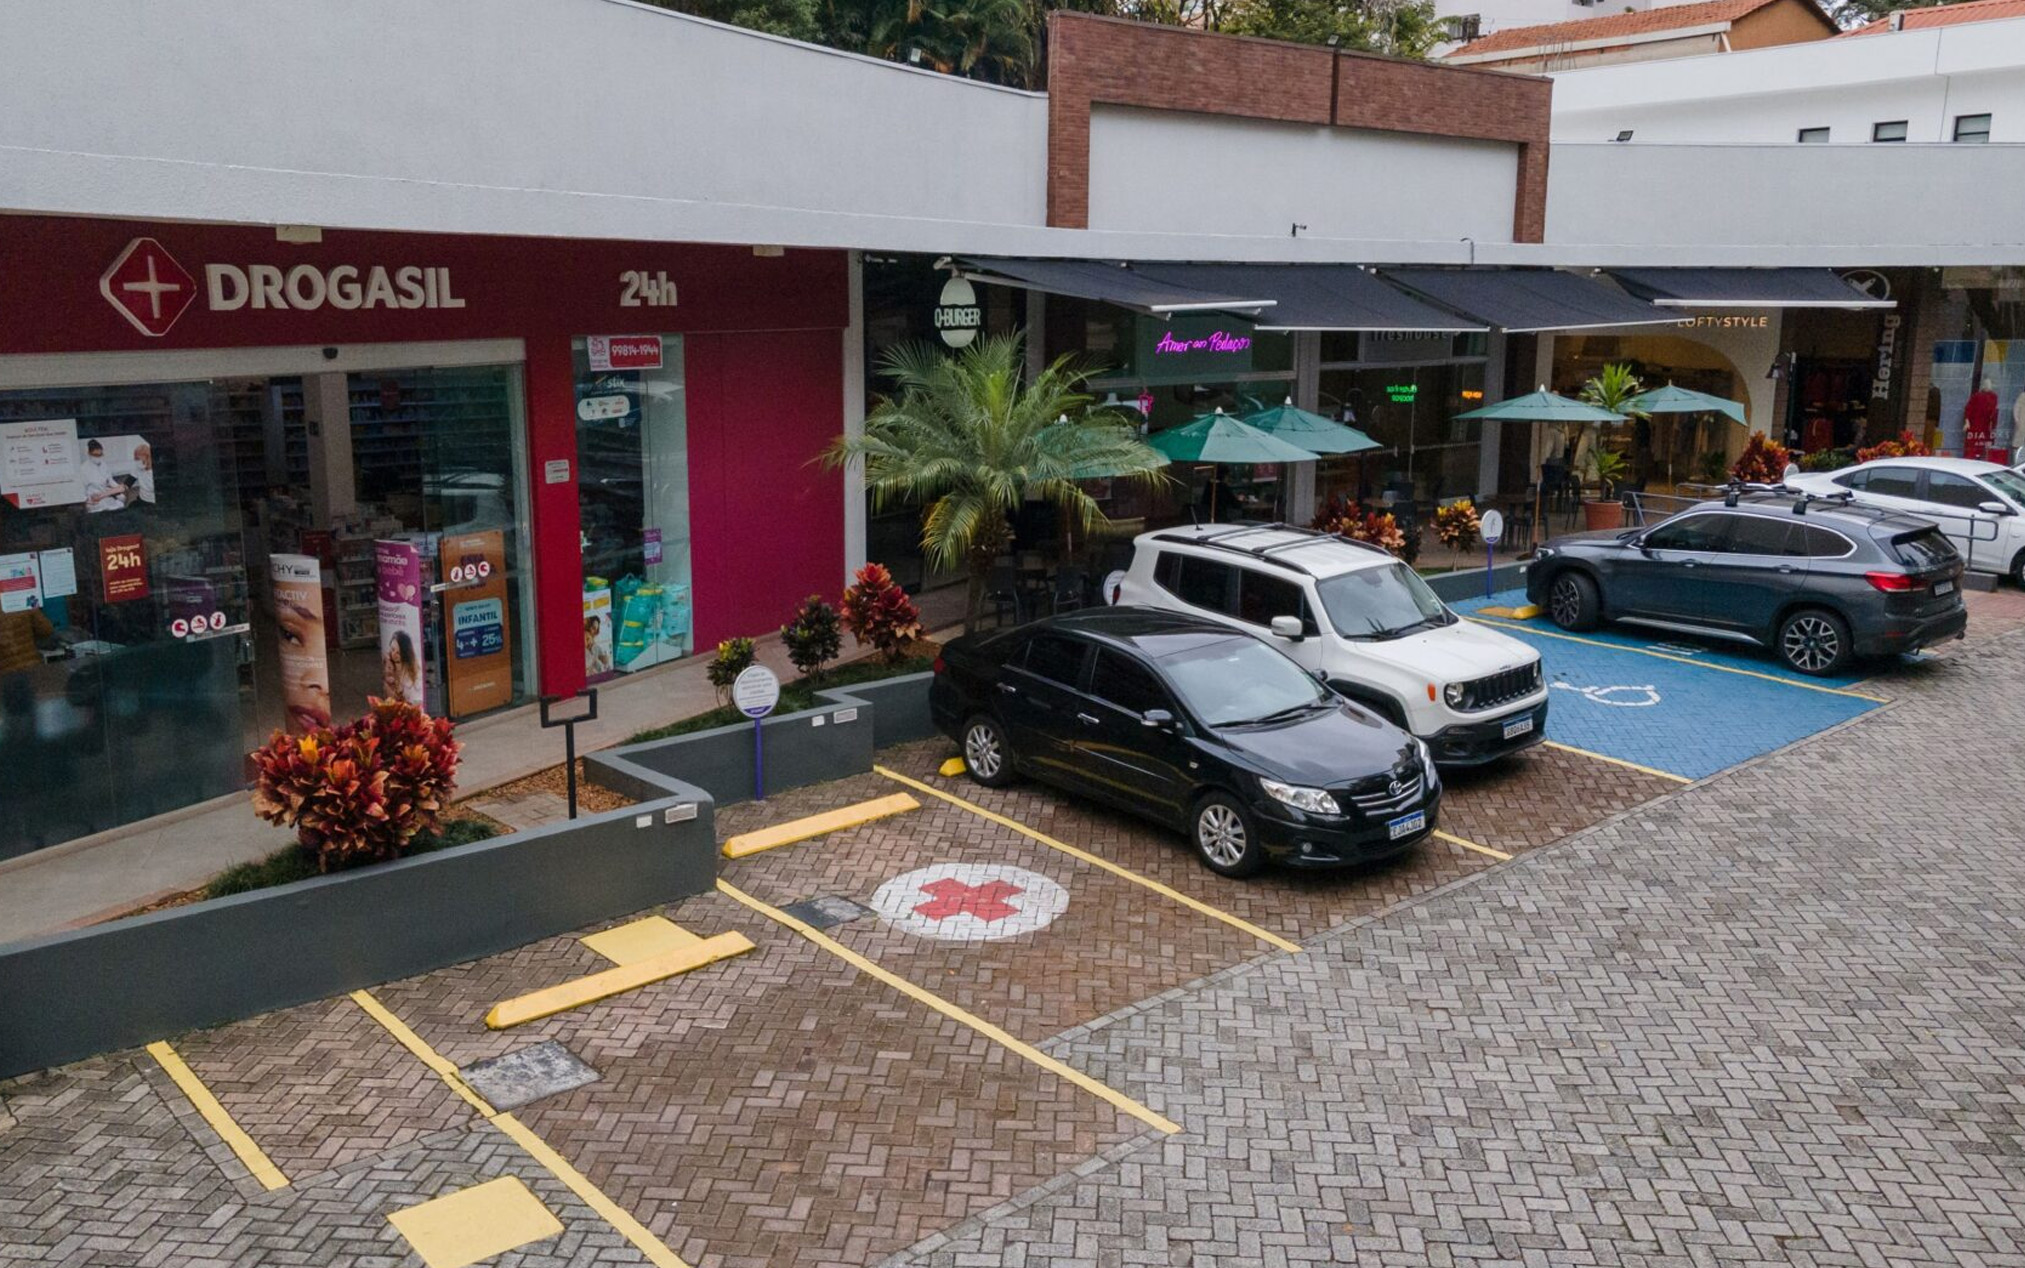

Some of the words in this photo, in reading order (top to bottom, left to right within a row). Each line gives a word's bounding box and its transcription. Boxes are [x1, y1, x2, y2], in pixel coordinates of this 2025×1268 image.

[205, 263, 466, 311] DROGASIL
[619, 270, 678, 307] 24h
[934, 308, 981, 328] Q-BURGER
[1155, 330, 1192, 354] Amor
[1871, 314, 1900, 400] Hering
[107, 552, 142, 570] 24h
[458, 611, 498, 625] INFANTIL
